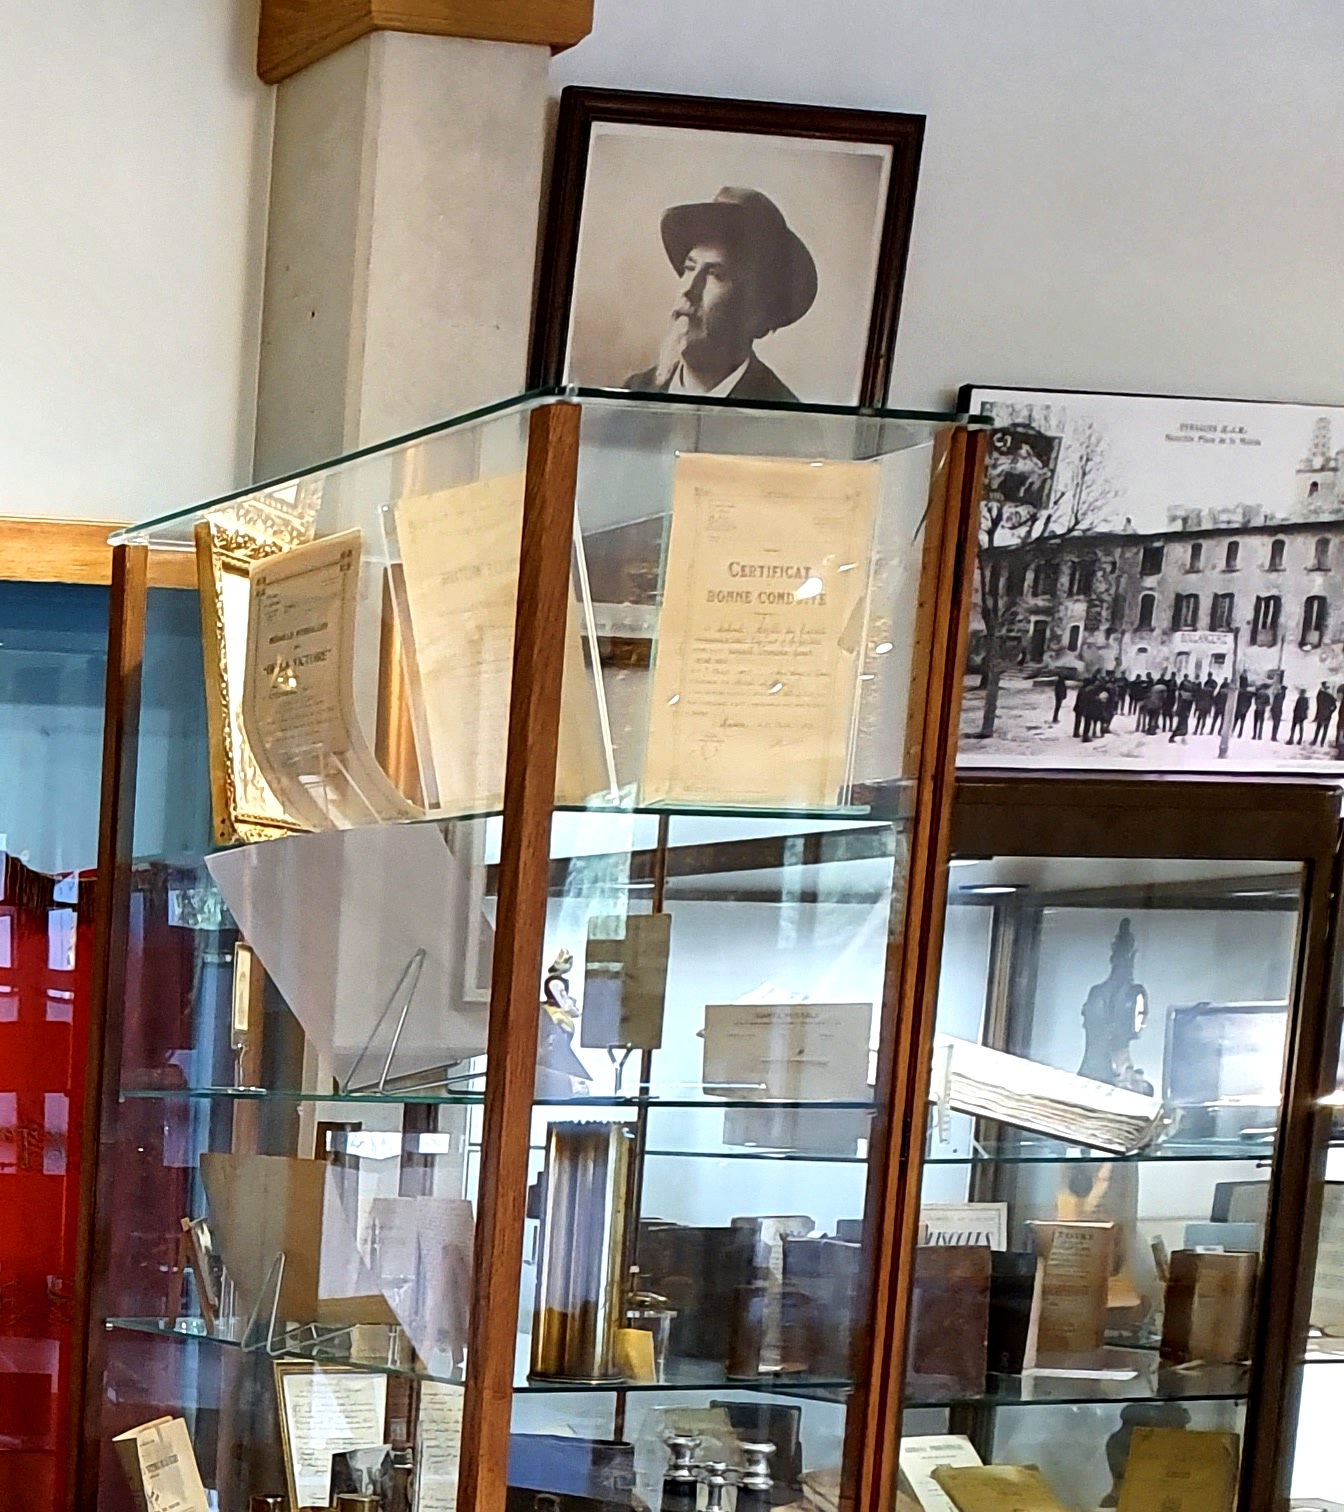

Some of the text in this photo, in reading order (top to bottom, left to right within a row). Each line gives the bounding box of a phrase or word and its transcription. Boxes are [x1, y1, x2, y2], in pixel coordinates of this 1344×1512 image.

[728, 561, 812, 579] CERTIFICAT
[706, 589, 827, 606] BONNE CONDTE
